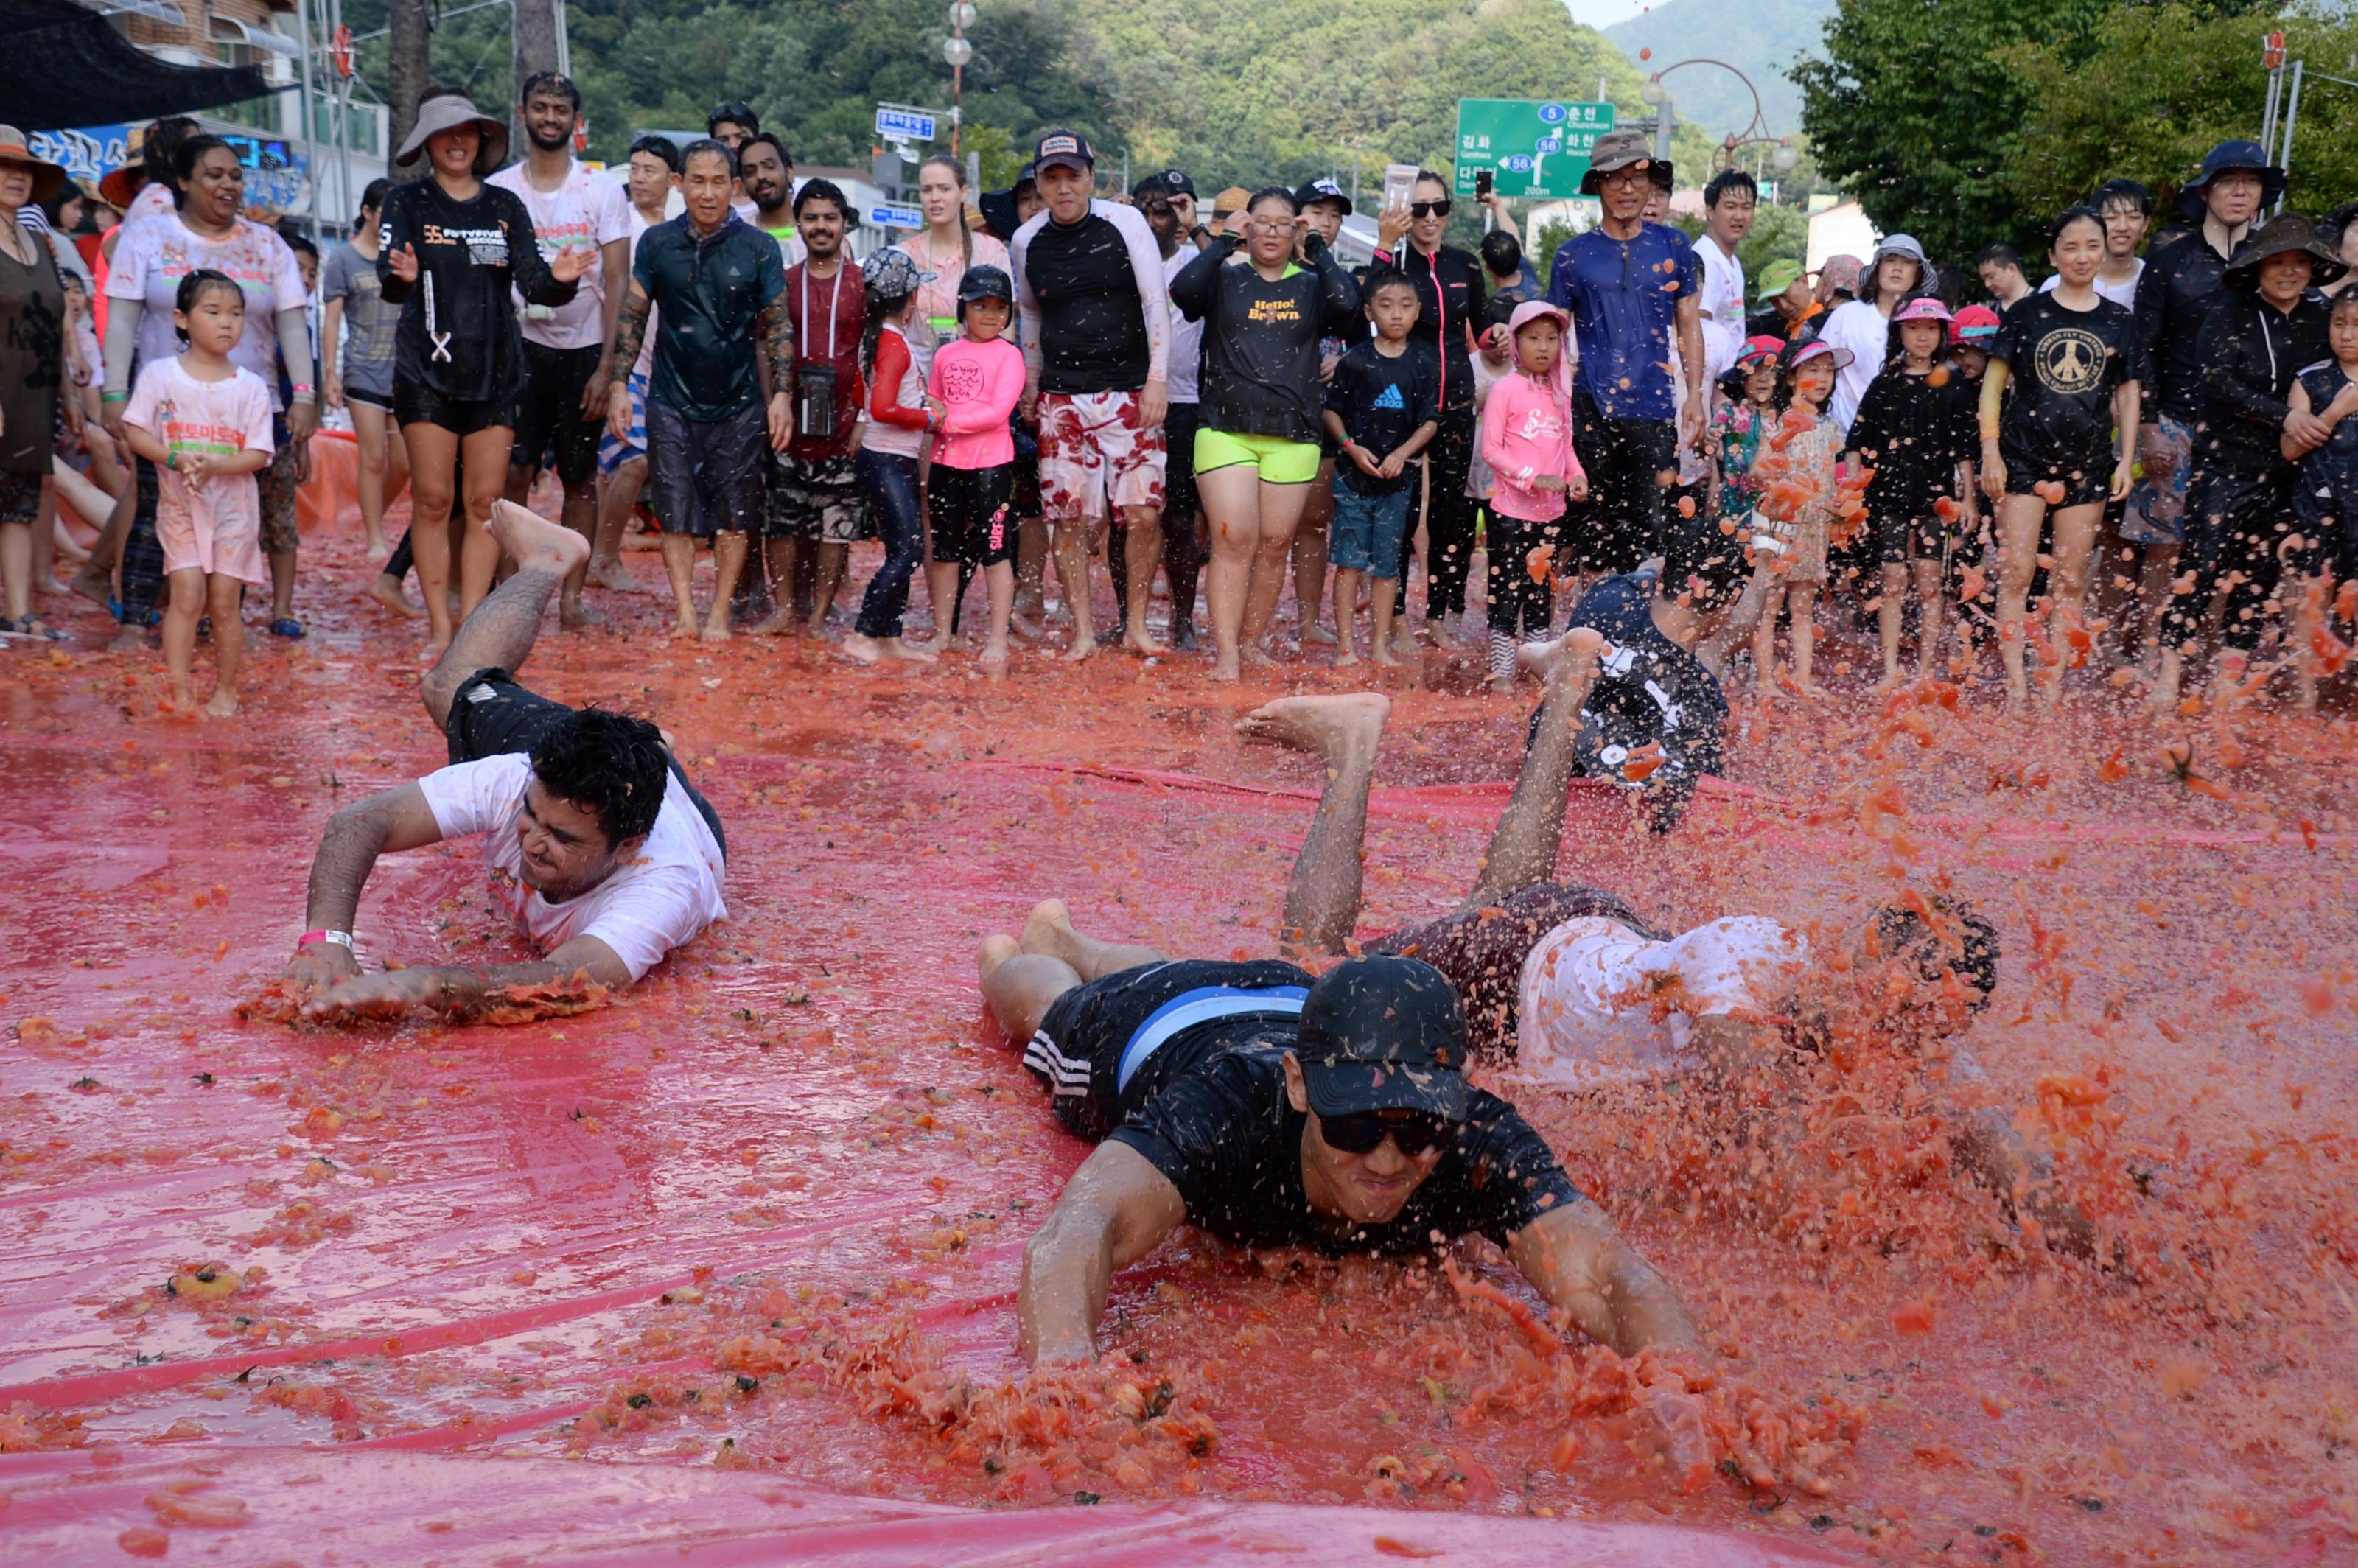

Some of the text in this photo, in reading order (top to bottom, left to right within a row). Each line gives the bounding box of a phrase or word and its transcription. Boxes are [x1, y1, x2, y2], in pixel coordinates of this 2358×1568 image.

[1547, 108, 1556, 119] 5
[1569, 107, 1596, 121] 춘천
[1567, 121, 1609, 130] Chuncheon
[1463, 135, 1490, 149] 김화
[1567, 134, 1595, 147] 화천
[1540, 141, 1556, 152] 56
[1567, 149, 1591, 157] Hwach
[1512, 158, 1528, 169] 56
[1525, 186, 1550, 195] 200m
[1255, 298, 1295, 309] Hello!
[1248, 308, 1301, 321] Brwn
[990, 522, 1004, 550] SURF
